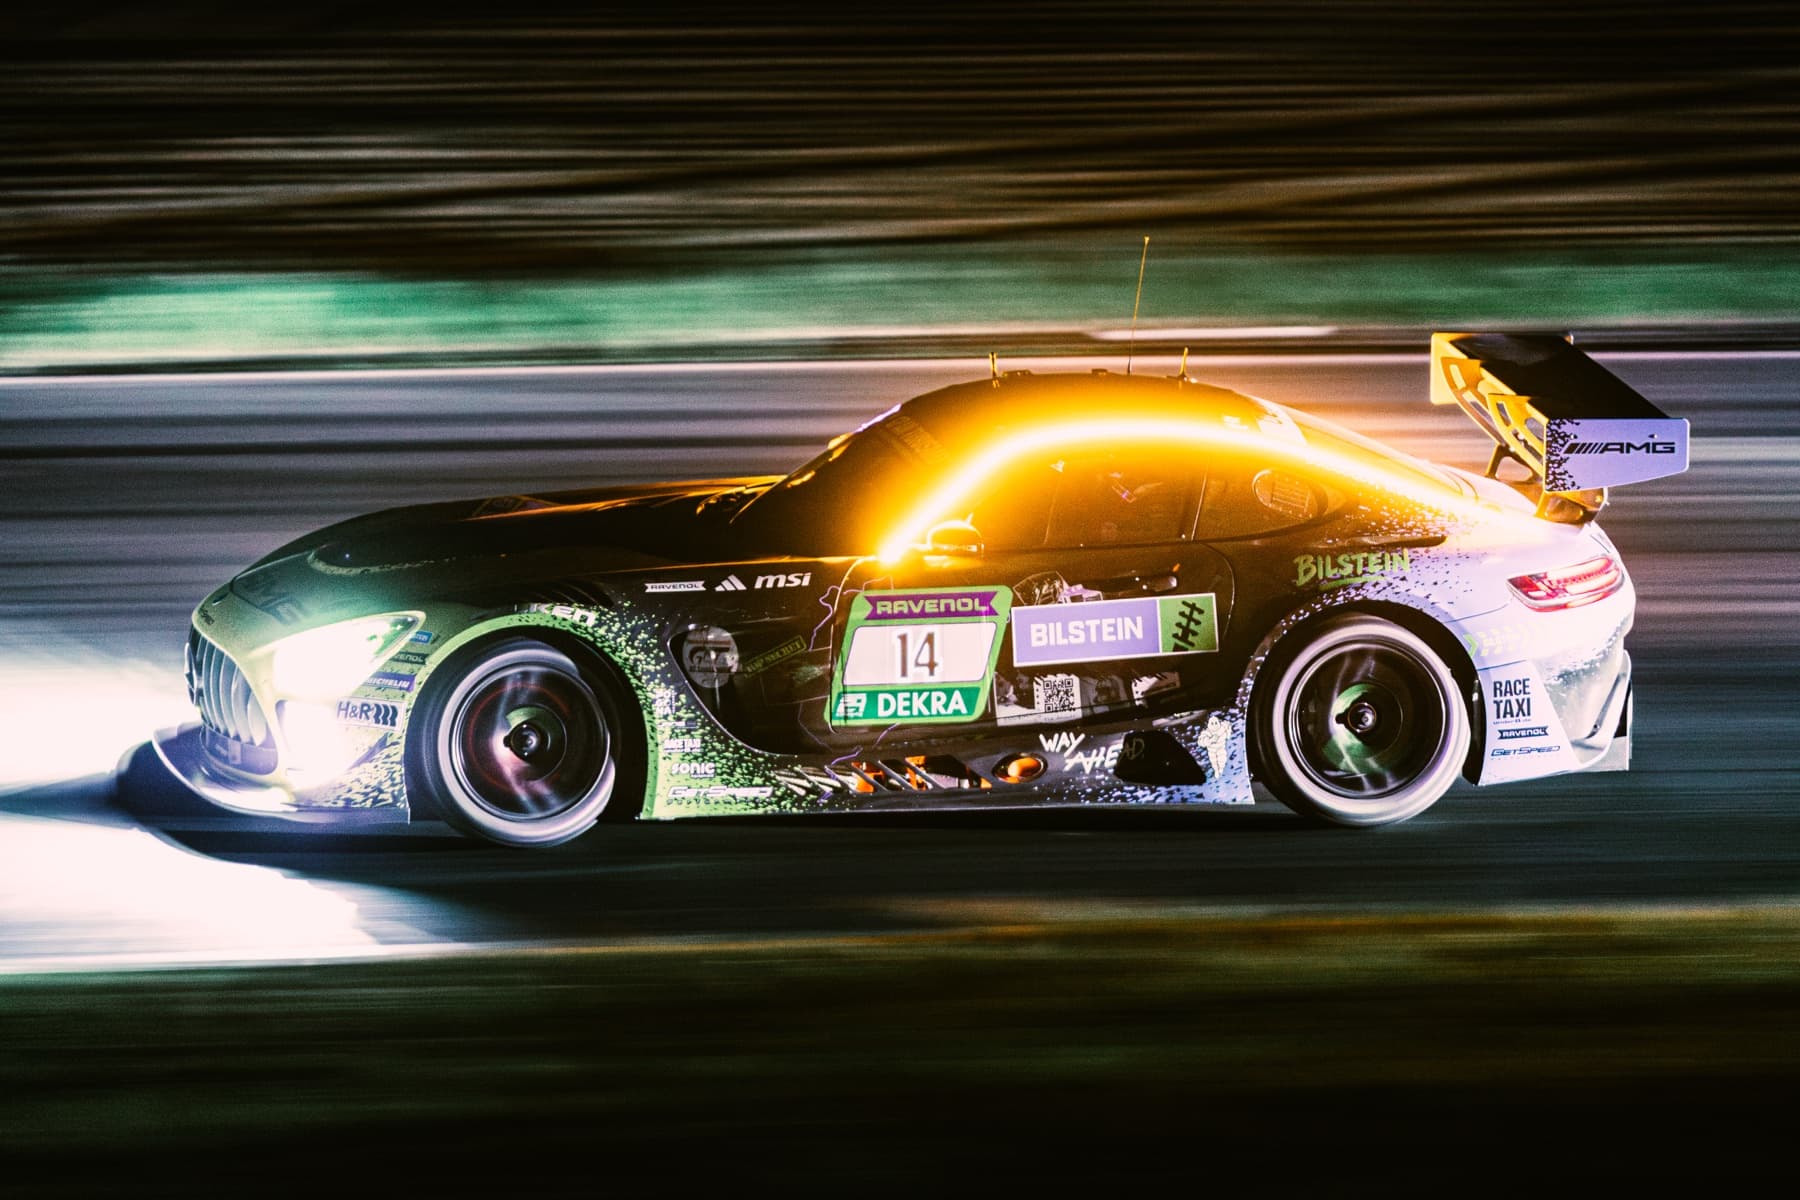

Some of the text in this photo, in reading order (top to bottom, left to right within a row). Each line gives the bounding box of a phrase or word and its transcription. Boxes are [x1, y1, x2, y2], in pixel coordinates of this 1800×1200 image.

[1599, 442, 1676, 455] AMG
[1294, 547, 1410, 586] BILSTEIN
[650, 583, 700, 591] RAVENOL
[876, 598, 989, 615] RAVENOL
[1030, 616, 1144, 648] BILSTEIN
[897, 631, 938, 678] 14
[1493, 678, 1531, 697] RACE
[337, 701, 371, 720] H&R
[877, 690, 968, 716] DEKRA
[1493, 698, 1531, 719] TAXI
[1502, 729, 1544, 737] RAVENOL
[1039, 731, 1085, 757] WAY
